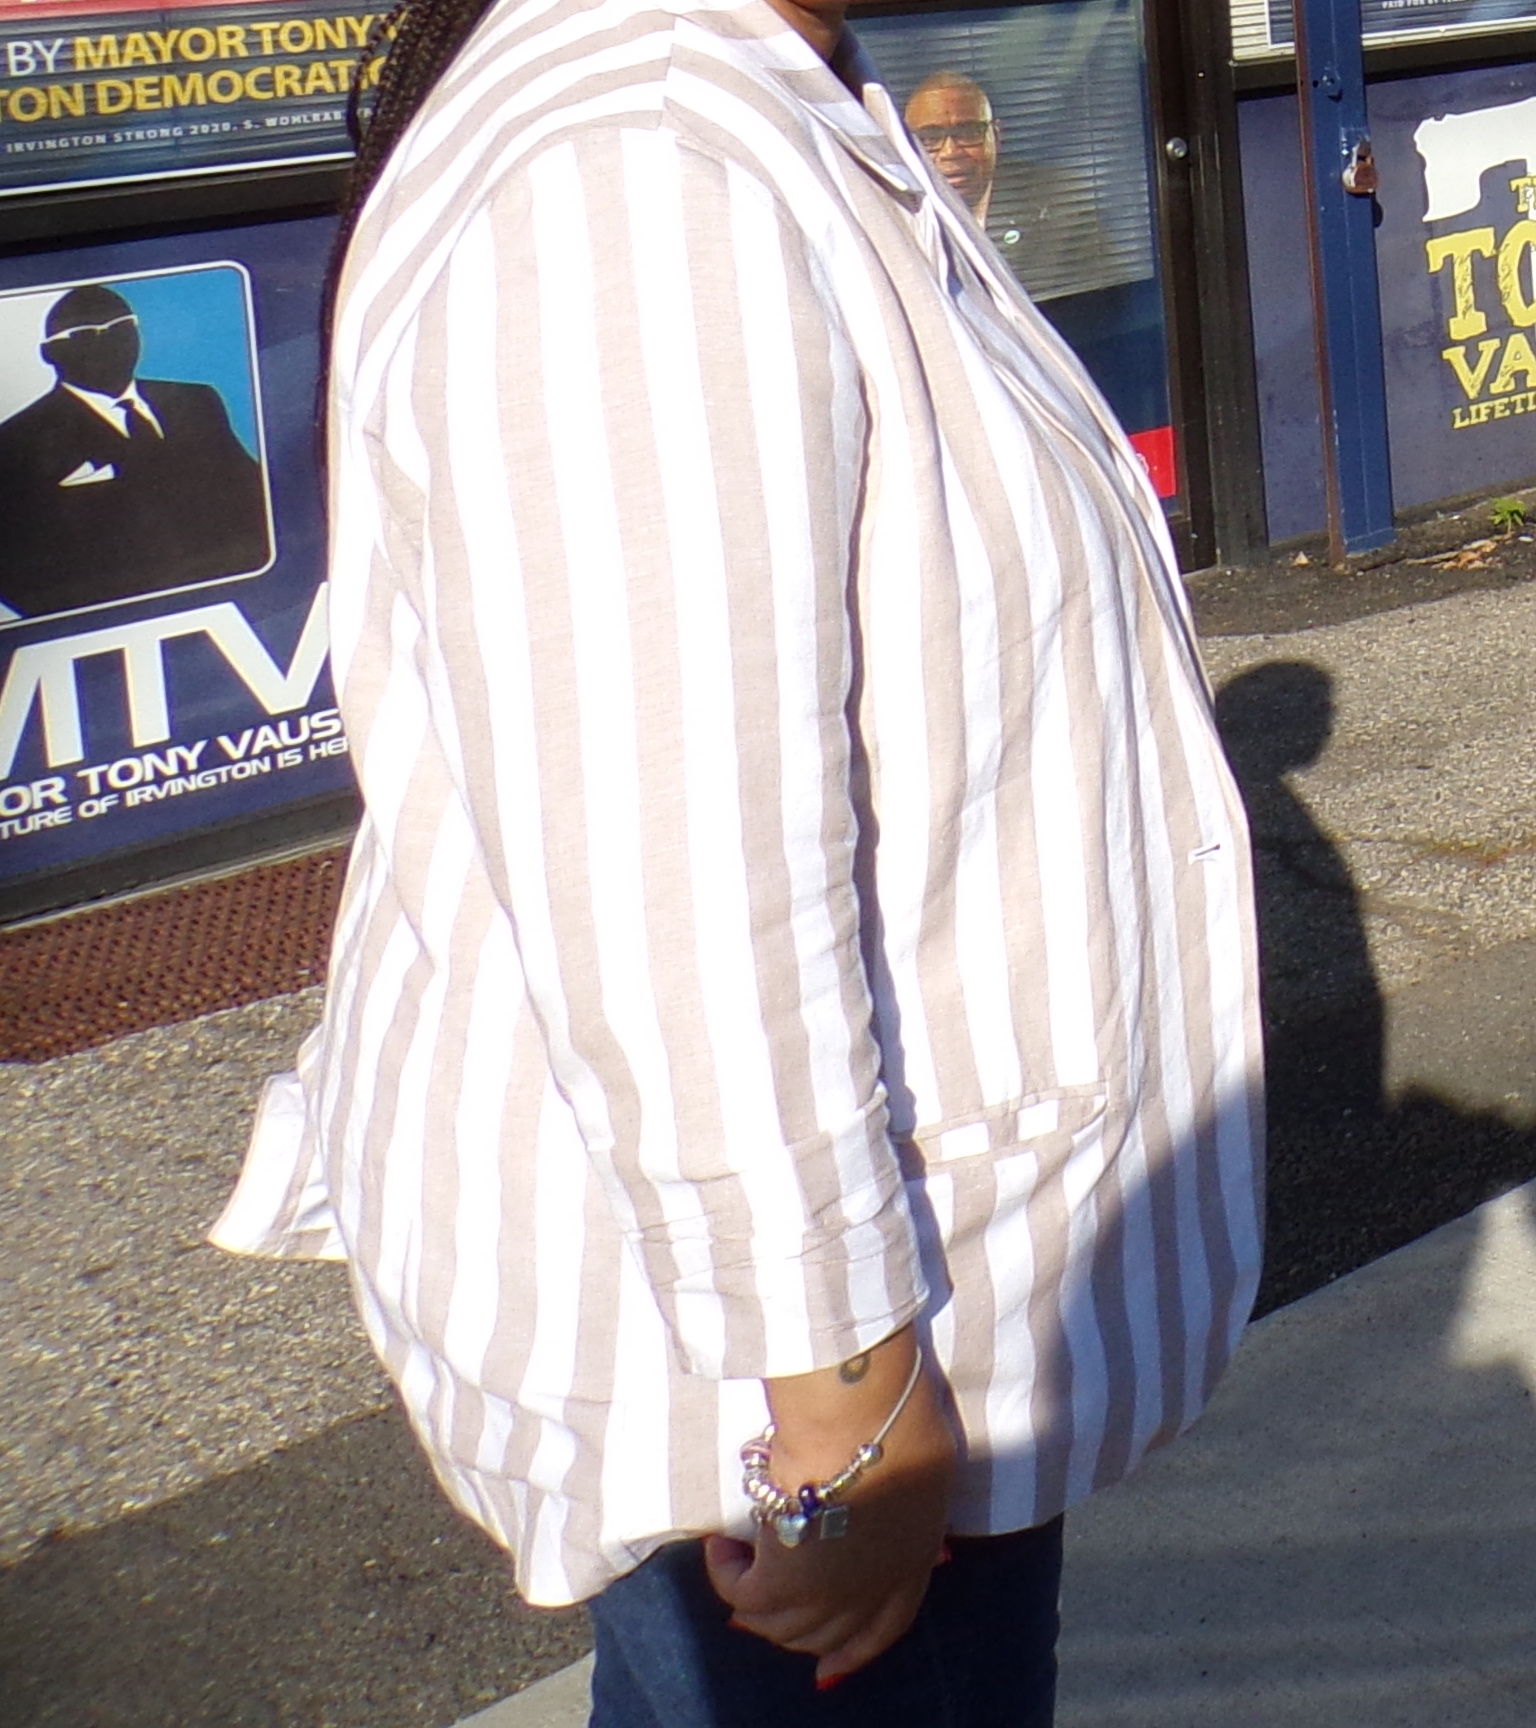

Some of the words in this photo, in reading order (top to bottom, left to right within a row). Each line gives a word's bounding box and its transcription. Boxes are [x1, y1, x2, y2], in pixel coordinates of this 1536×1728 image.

[6, 37, 64, 77] BY
[74, 24, 248, 71] MAYOR
[251, 13, 375, 56] TONY
[0, 82, 86, 123] ON
[6, 132, 107, 154] IRVINGTON
[113, 125, 184, 144] STRONG
[0, 777, 69, 818] OR
[77, 739, 208, 796] TONY
[218, 708, 344, 761] VAUS
[0, 807, 73, 840] TURE
[78, 793, 120, 819] OF
[125, 756, 273, 807] IRVINGTON
[277, 749, 304, 770] IS
